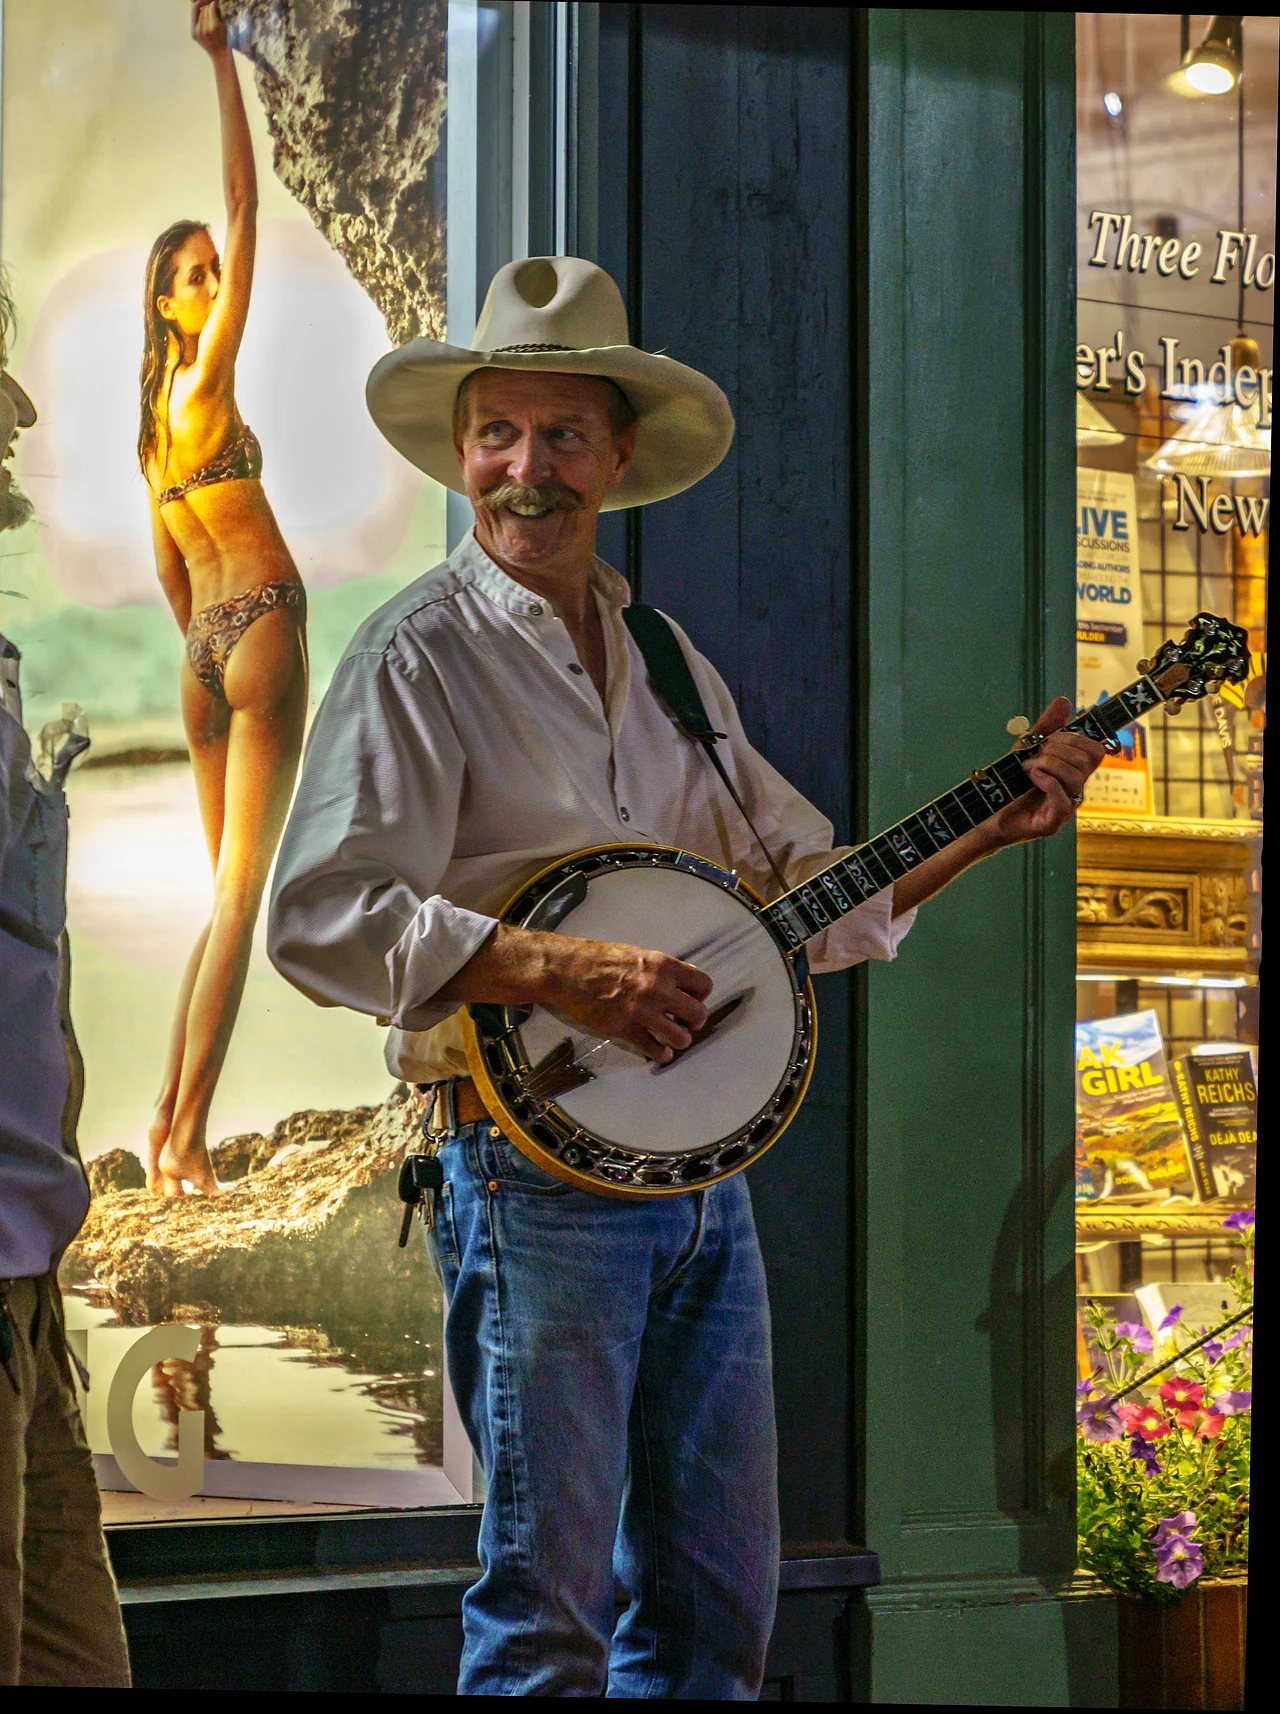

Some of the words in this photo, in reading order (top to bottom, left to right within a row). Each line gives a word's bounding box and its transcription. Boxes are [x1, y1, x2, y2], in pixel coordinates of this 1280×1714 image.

[1089, 211, 1202, 278] Three
[1173, 473, 1269, 537] New
[1077, 1042, 1125, 1071] AK
[1081, 1061, 1164, 1096] GIRL
[1204, 1067, 1239, 1082] KATHY
[1196, 1081, 1256, 1104] REICHS
